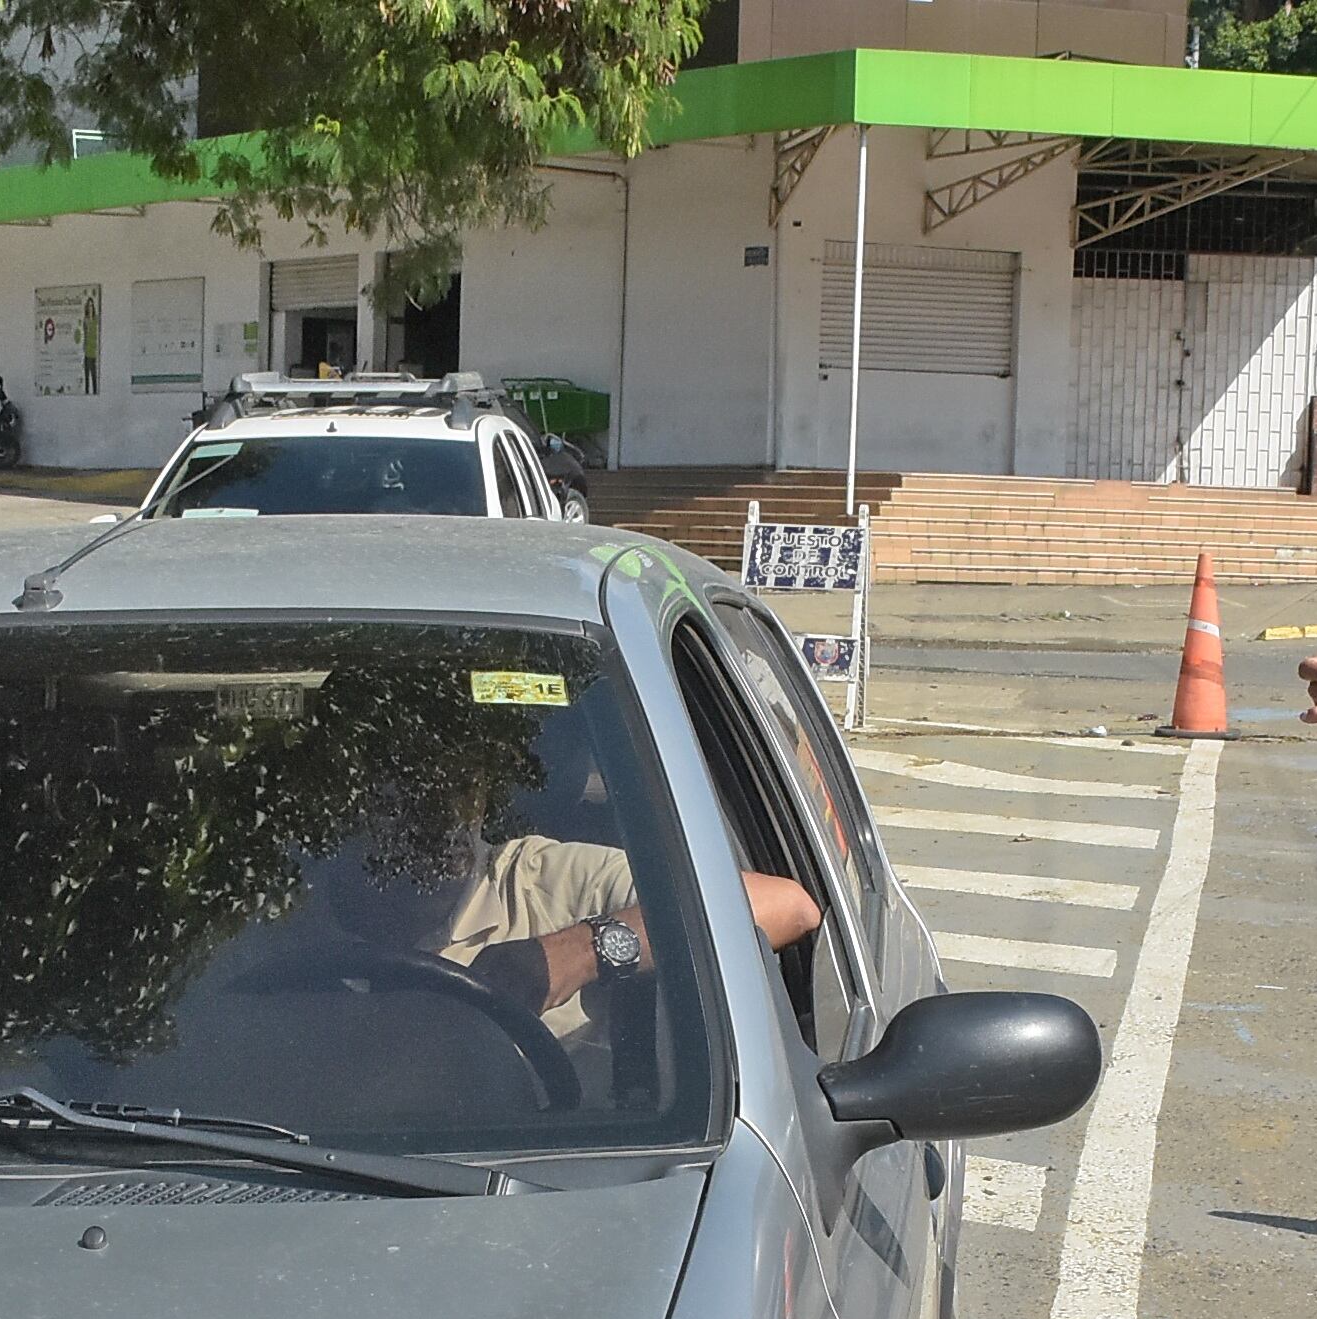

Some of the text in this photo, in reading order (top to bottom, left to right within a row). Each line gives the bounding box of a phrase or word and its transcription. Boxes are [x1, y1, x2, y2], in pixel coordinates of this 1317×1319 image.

[770, 533, 843, 548] PUESTO
[792, 550, 820, 562] DE
[761, 564, 849, 579] CONTROL
